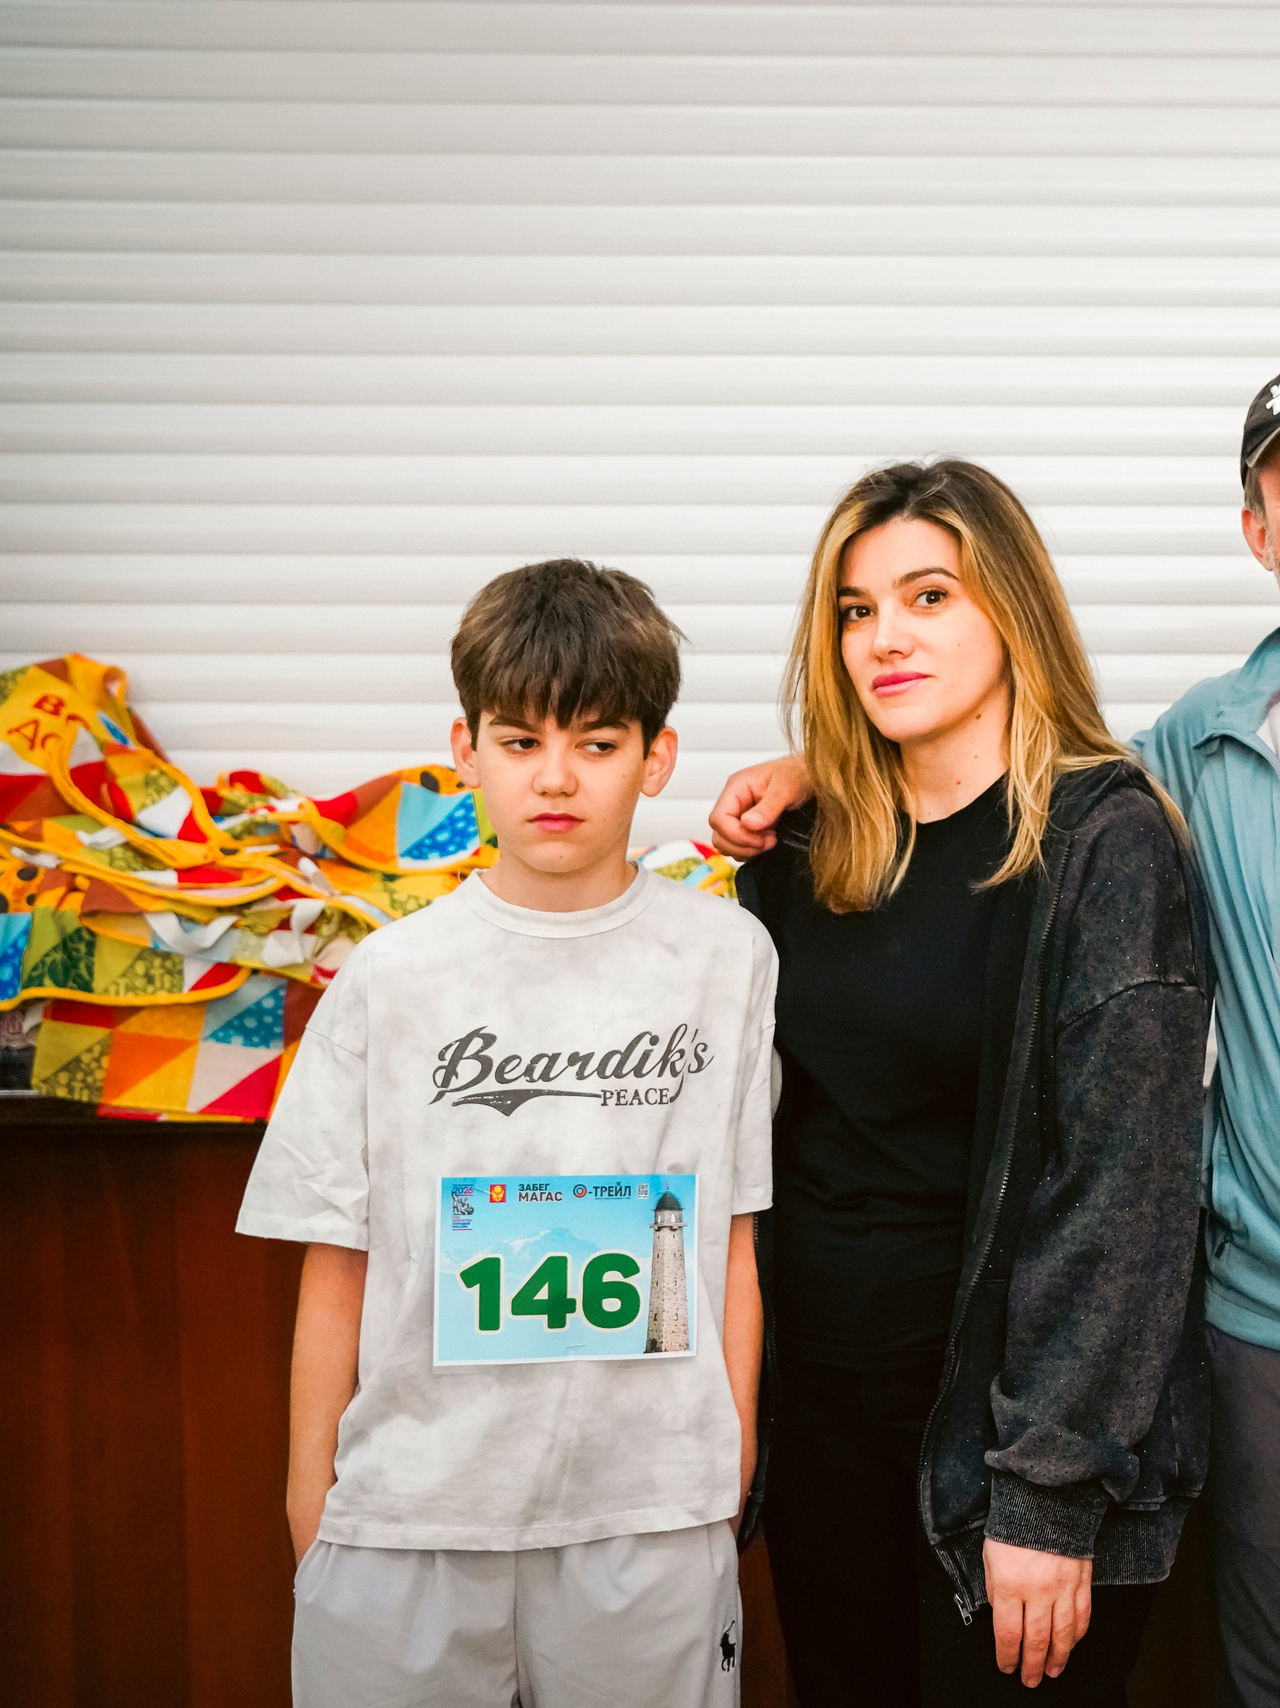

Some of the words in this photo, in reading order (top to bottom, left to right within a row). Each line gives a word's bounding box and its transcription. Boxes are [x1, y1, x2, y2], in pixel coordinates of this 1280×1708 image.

[430, 1023, 715, 1100] Beardik's
[601, 1088, 670, 1106] PEACE
[518, 1183, 550, 1192] ЗАБЕГ
[518, 1191, 563, 1202] МАГАС
[459, 1252, 642, 1331] 146
